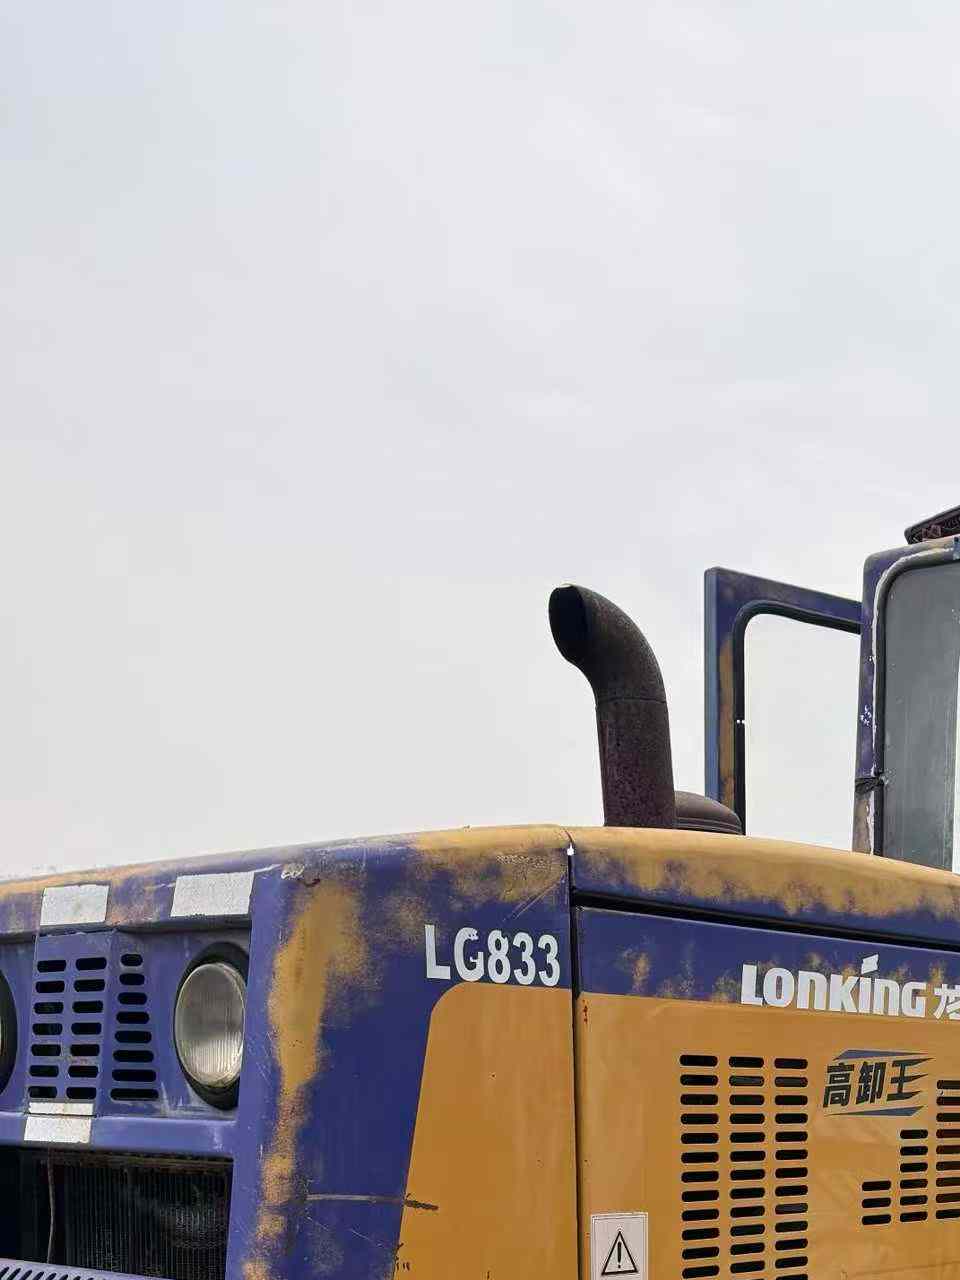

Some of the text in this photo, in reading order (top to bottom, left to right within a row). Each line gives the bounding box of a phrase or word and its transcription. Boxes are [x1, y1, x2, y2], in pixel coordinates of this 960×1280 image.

[424, 924, 560, 987] LG833
[823, 1057, 936, 1108] 高卸王
